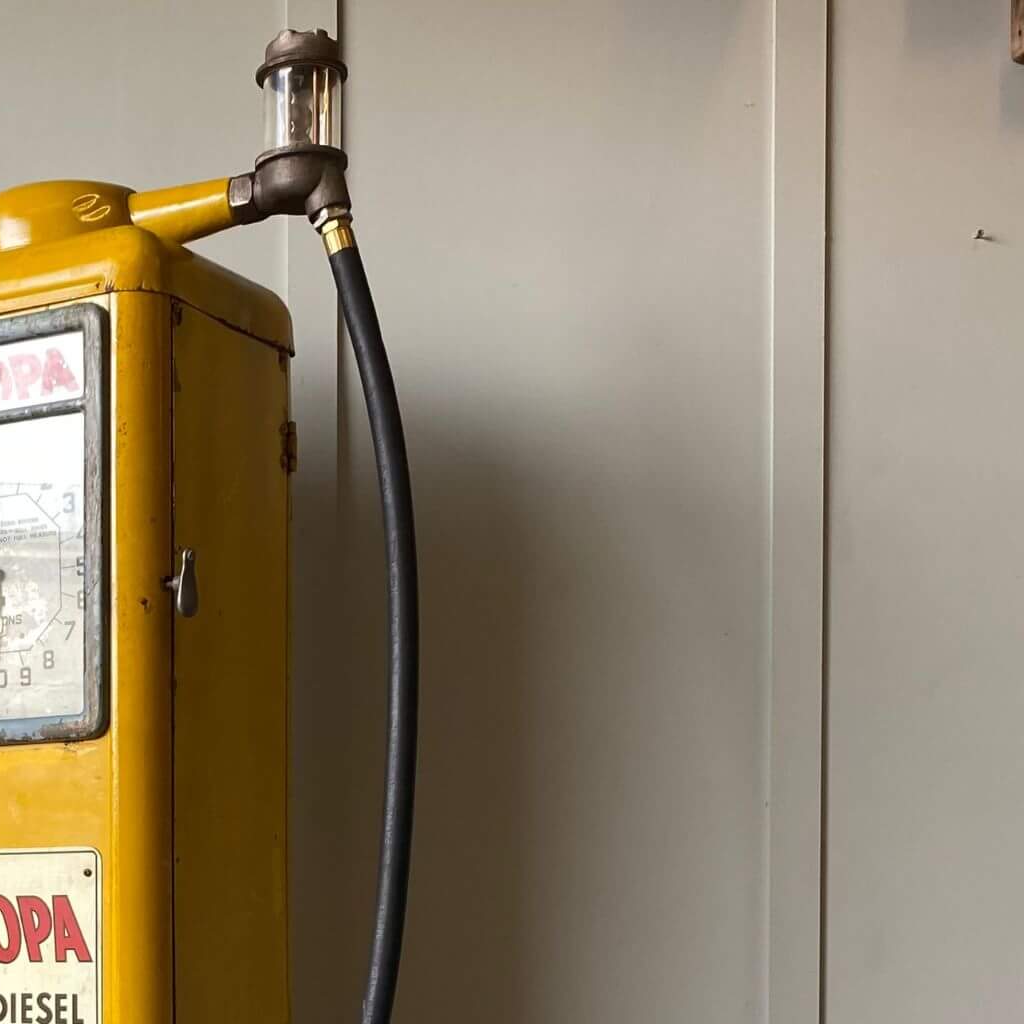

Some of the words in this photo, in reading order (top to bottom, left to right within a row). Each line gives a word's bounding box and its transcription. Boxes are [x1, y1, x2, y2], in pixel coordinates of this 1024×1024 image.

[63, 492, 75, 513] 3
[64, 620, 76, 640] 7
[43, 650, 55, 669] 8
[20, 667, 32, 686] 9
